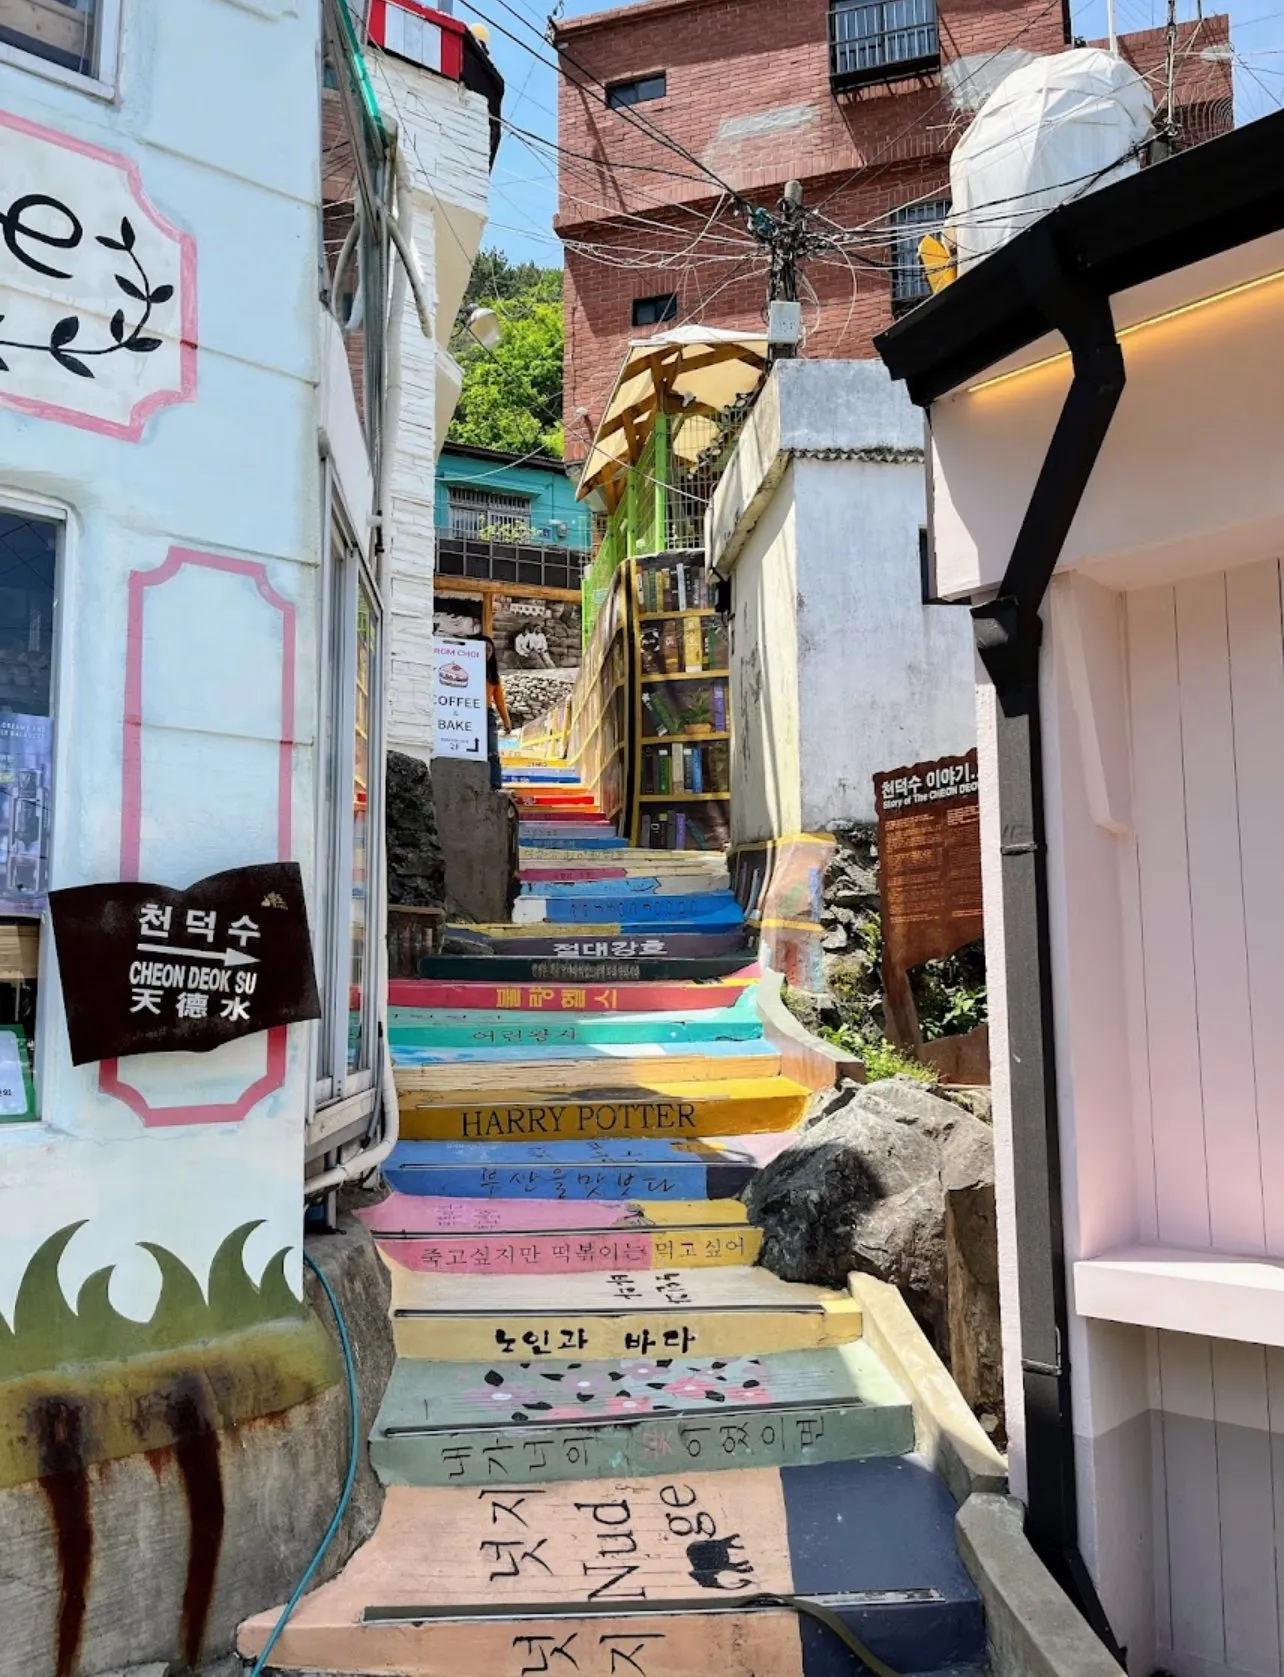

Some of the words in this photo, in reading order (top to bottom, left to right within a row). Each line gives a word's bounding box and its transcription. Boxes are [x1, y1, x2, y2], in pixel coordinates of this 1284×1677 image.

[437, 720, 472, 732] BAKE
[882, 775, 922, 800] 천덕수
[883, 799, 903, 810] Story
[904, 797, 911, 805] of
[929, 787, 957, 799] CHEON
[129, 961, 186, 989] CHEON
[188, 966, 232, 993] DEOK
[234, 971, 258, 995] SU
[462, 1105, 570, 1137] HARRY
[577, 1102, 697, 1131] POTTER
[494, 1327, 589, 1355] 노인과
[624, 1326, 699, 1355] 바다
[478, 1488, 555, 1582] 넛지
